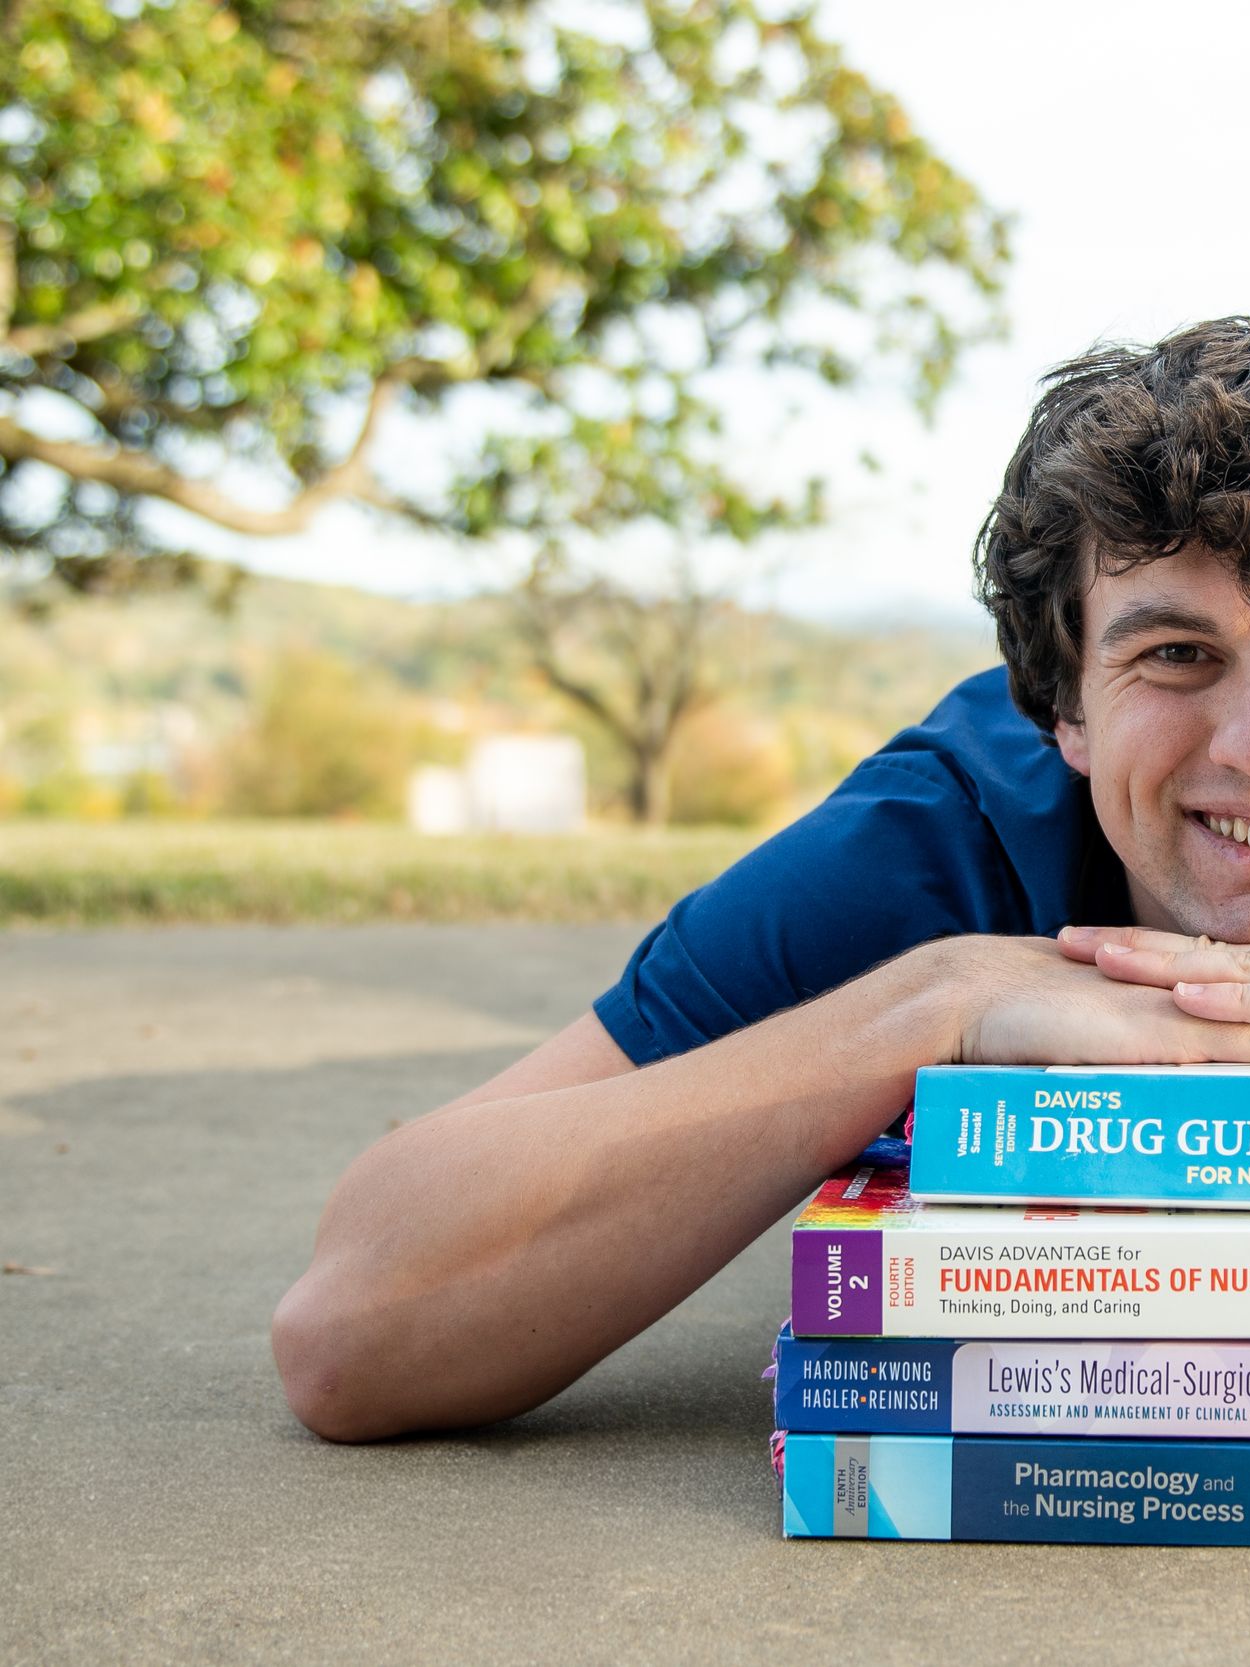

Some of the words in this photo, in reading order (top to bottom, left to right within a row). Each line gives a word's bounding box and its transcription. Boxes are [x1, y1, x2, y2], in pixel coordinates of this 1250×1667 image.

[1034, 1090, 1122, 1110] DAVIS'S
[957, 1108, 969, 1157] Vallerand
[971, 1112, 982, 1154] Sanoski
[994, 1100, 1006, 1166] SEVENTEENTH
[1006, 1115, 1016, 1152] EDITION
[1028, 1116, 1166, 1155] DRUG
[1186, 1166, 1232, 1185] FOR
[940, 1246, 994, 1261] DAVIS
[999, 1246, 1111, 1261] ADVANTAGE
[1117, 1246, 1141, 1261] for
[828, 1244, 842, 1321] VOLUME
[850, 1275, 869, 1290] 2
[889, 1257, 900, 1308] FOURTH
[904, 1257, 915, 1307] EDITION
[940, 1268, 1160, 1293] FUNDAMENTALS
[1169, 1268, 1202, 1292] OF
[940, 1299, 1005, 1317] Thinking,
[1010, 1299, 1057, 1317] Doing,
[1062, 1299, 1089, 1314] and
[1093, 1299, 1141, 1317] Caring
[803, 1360, 869, 1381] HARDING
[879, 1361, 932, 1383] KWONG
[988, 1358, 1071, 1394] Lewis's
[803, 1389, 860, 1410] HAGLER
[869, 1390, 939, 1411] REINISCH
[989, 1404, 1062, 1418] ASSESSMENT
[1066, 1405, 1089, 1419] AND
[1094, 1405, 1172, 1420] MANAGEMENT
[1177, 1407, 1190, 1420] OF
[1196, 1407, 1247, 1421] CLINICAL
[837, 1469, 846, 1504] TENTH
[845, 1456, 859, 1516] Anniversary
[857, 1466, 867, 1508] EDITION
[1015, 1462, 1199, 1496] Pharmacology
[1203, 1476, 1235, 1492] and
[1003, 1500, 1030, 1517] the
[1035, 1493, 1135, 1524] Nursing
[1143, 1496, 1245, 1523] Process
